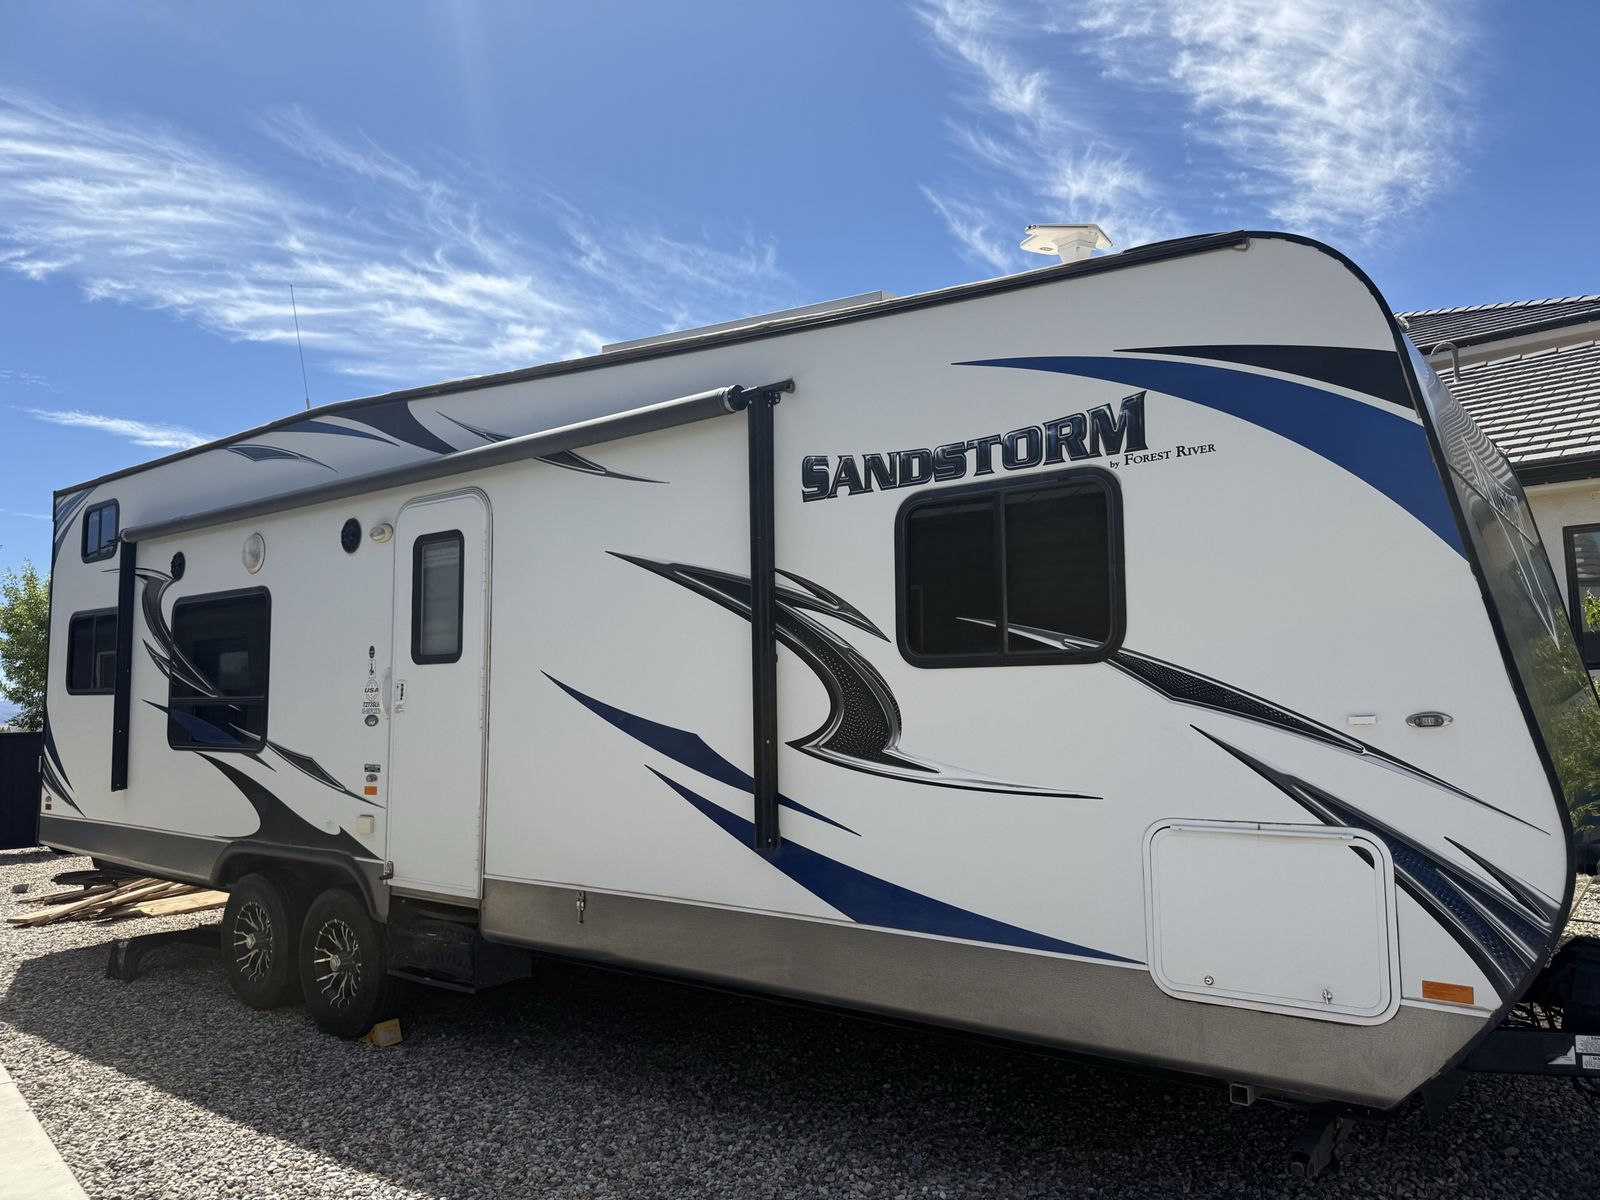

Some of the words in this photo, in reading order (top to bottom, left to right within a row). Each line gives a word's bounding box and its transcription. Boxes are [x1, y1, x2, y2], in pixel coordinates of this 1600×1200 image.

[802, 390, 1148, 502] SANDSTORM
[1109, 460, 1120, 469] by
[1124, 451, 1171, 466] FOREST
[1176, 443, 1216, 458] RIVER
